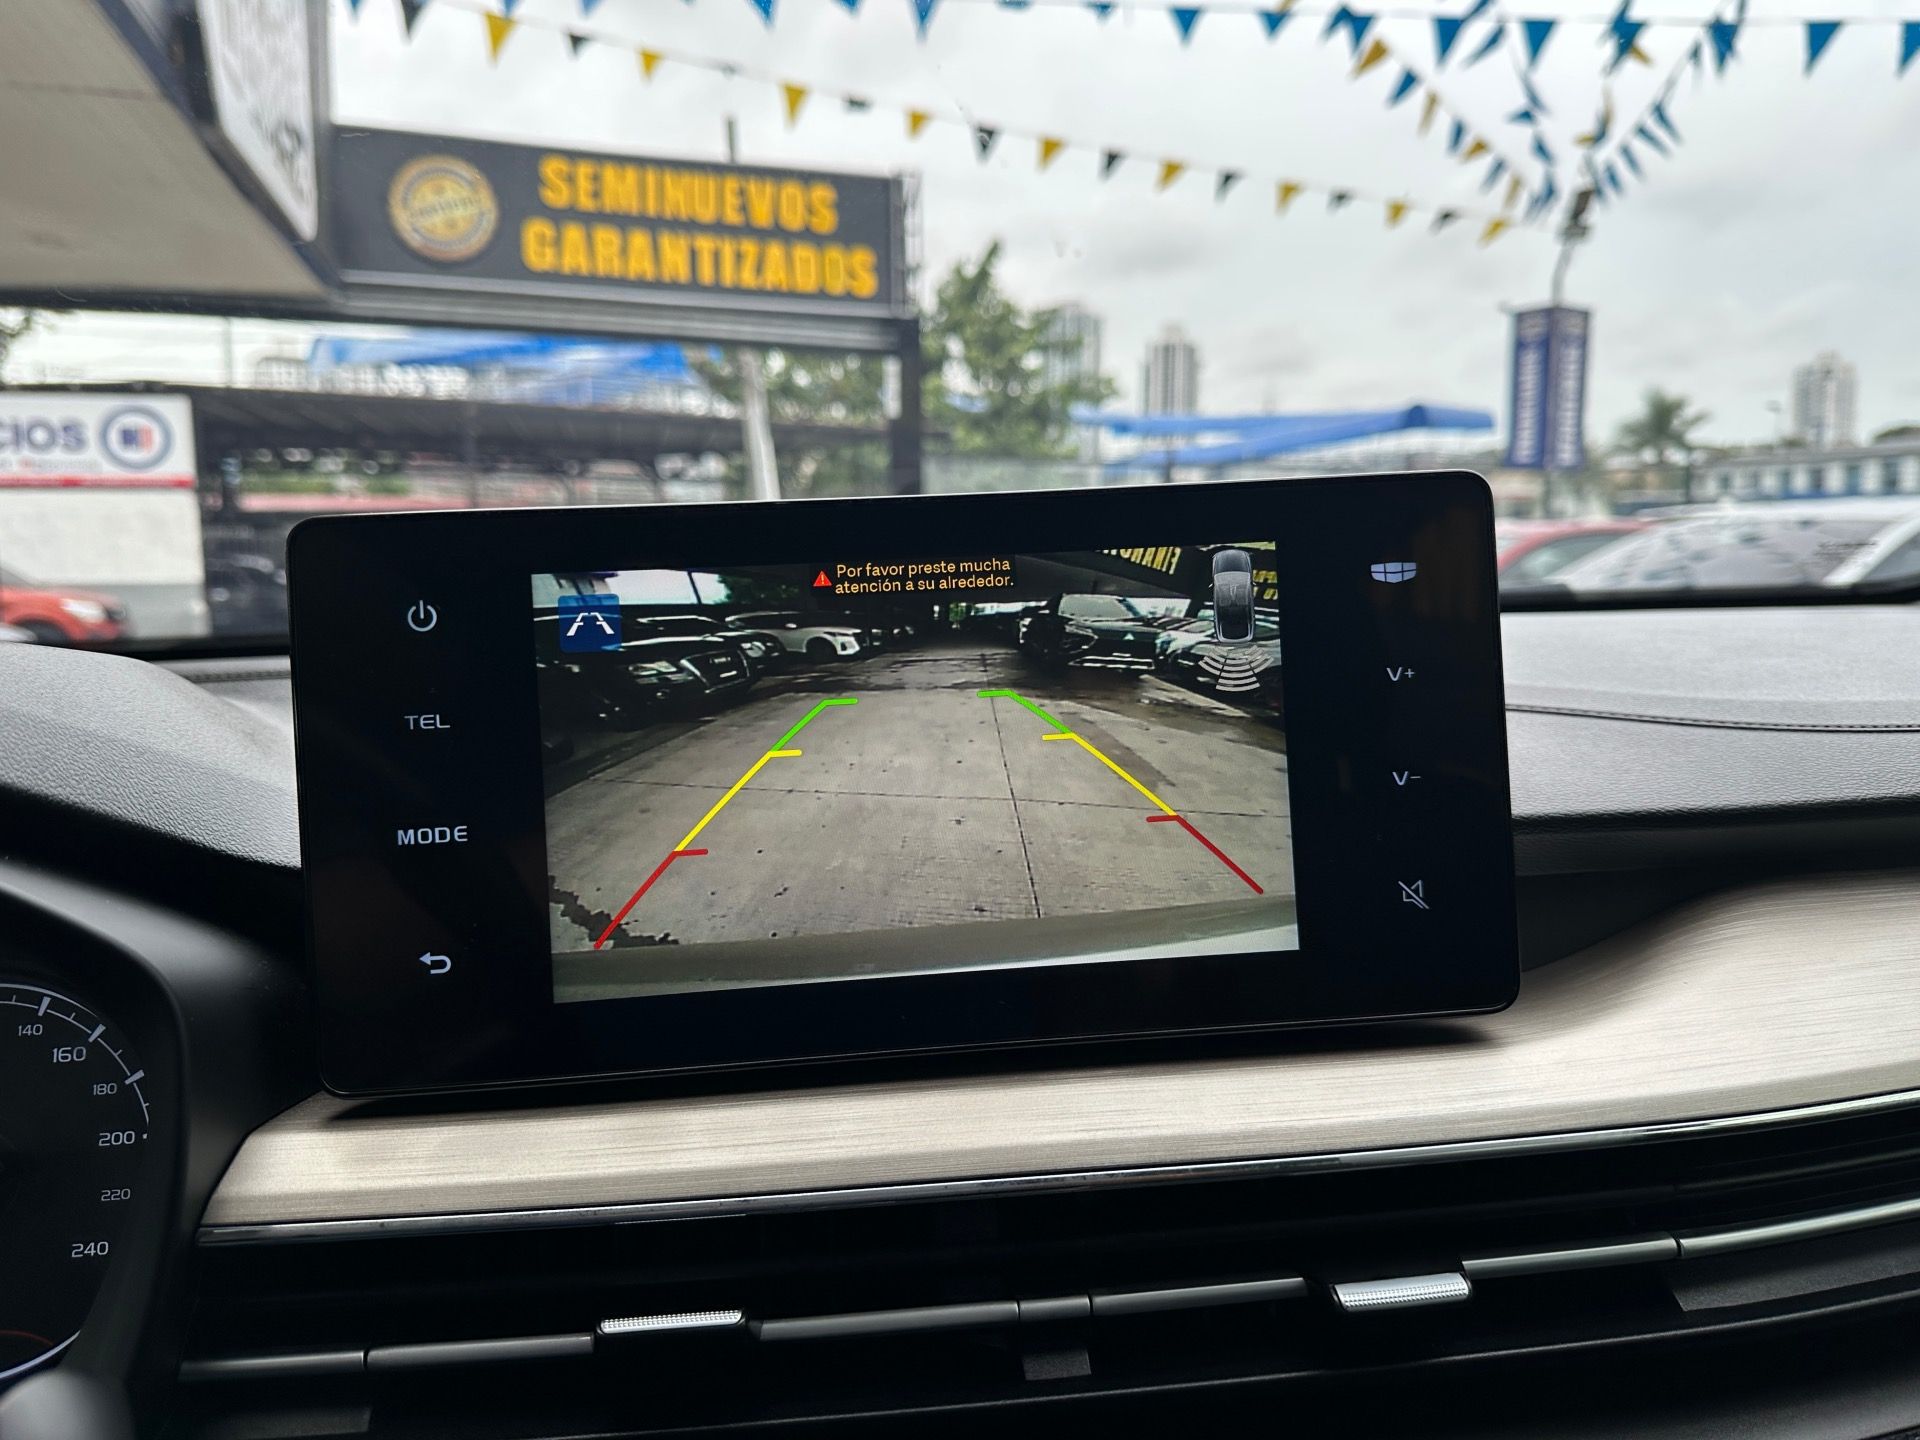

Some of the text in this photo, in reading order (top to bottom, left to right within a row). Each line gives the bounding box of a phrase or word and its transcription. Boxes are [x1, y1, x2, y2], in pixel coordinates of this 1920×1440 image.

[538, 154, 839, 236] SEMINUEVOS
[519, 215, 880, 299] GARANTIZADOS
[836, 558, 1011, 578] Por favor preste mucha
[835, 573, 1015, 594] atención a su alrededor.
[1386, 666, 1415, 682] V+
[404, 714, 451, 730] TEL
[397, 825, 469, 846] MODE
[18, 1023, 43, 1037] 140
[52, 1046, 87, 1063] 160
[92, 1082, 118, 1096] 180
[98, 1130, 136, 1147] 200
[101, 1188, 131, 1201] 220
[71, 1241, 109, 1258] 240
